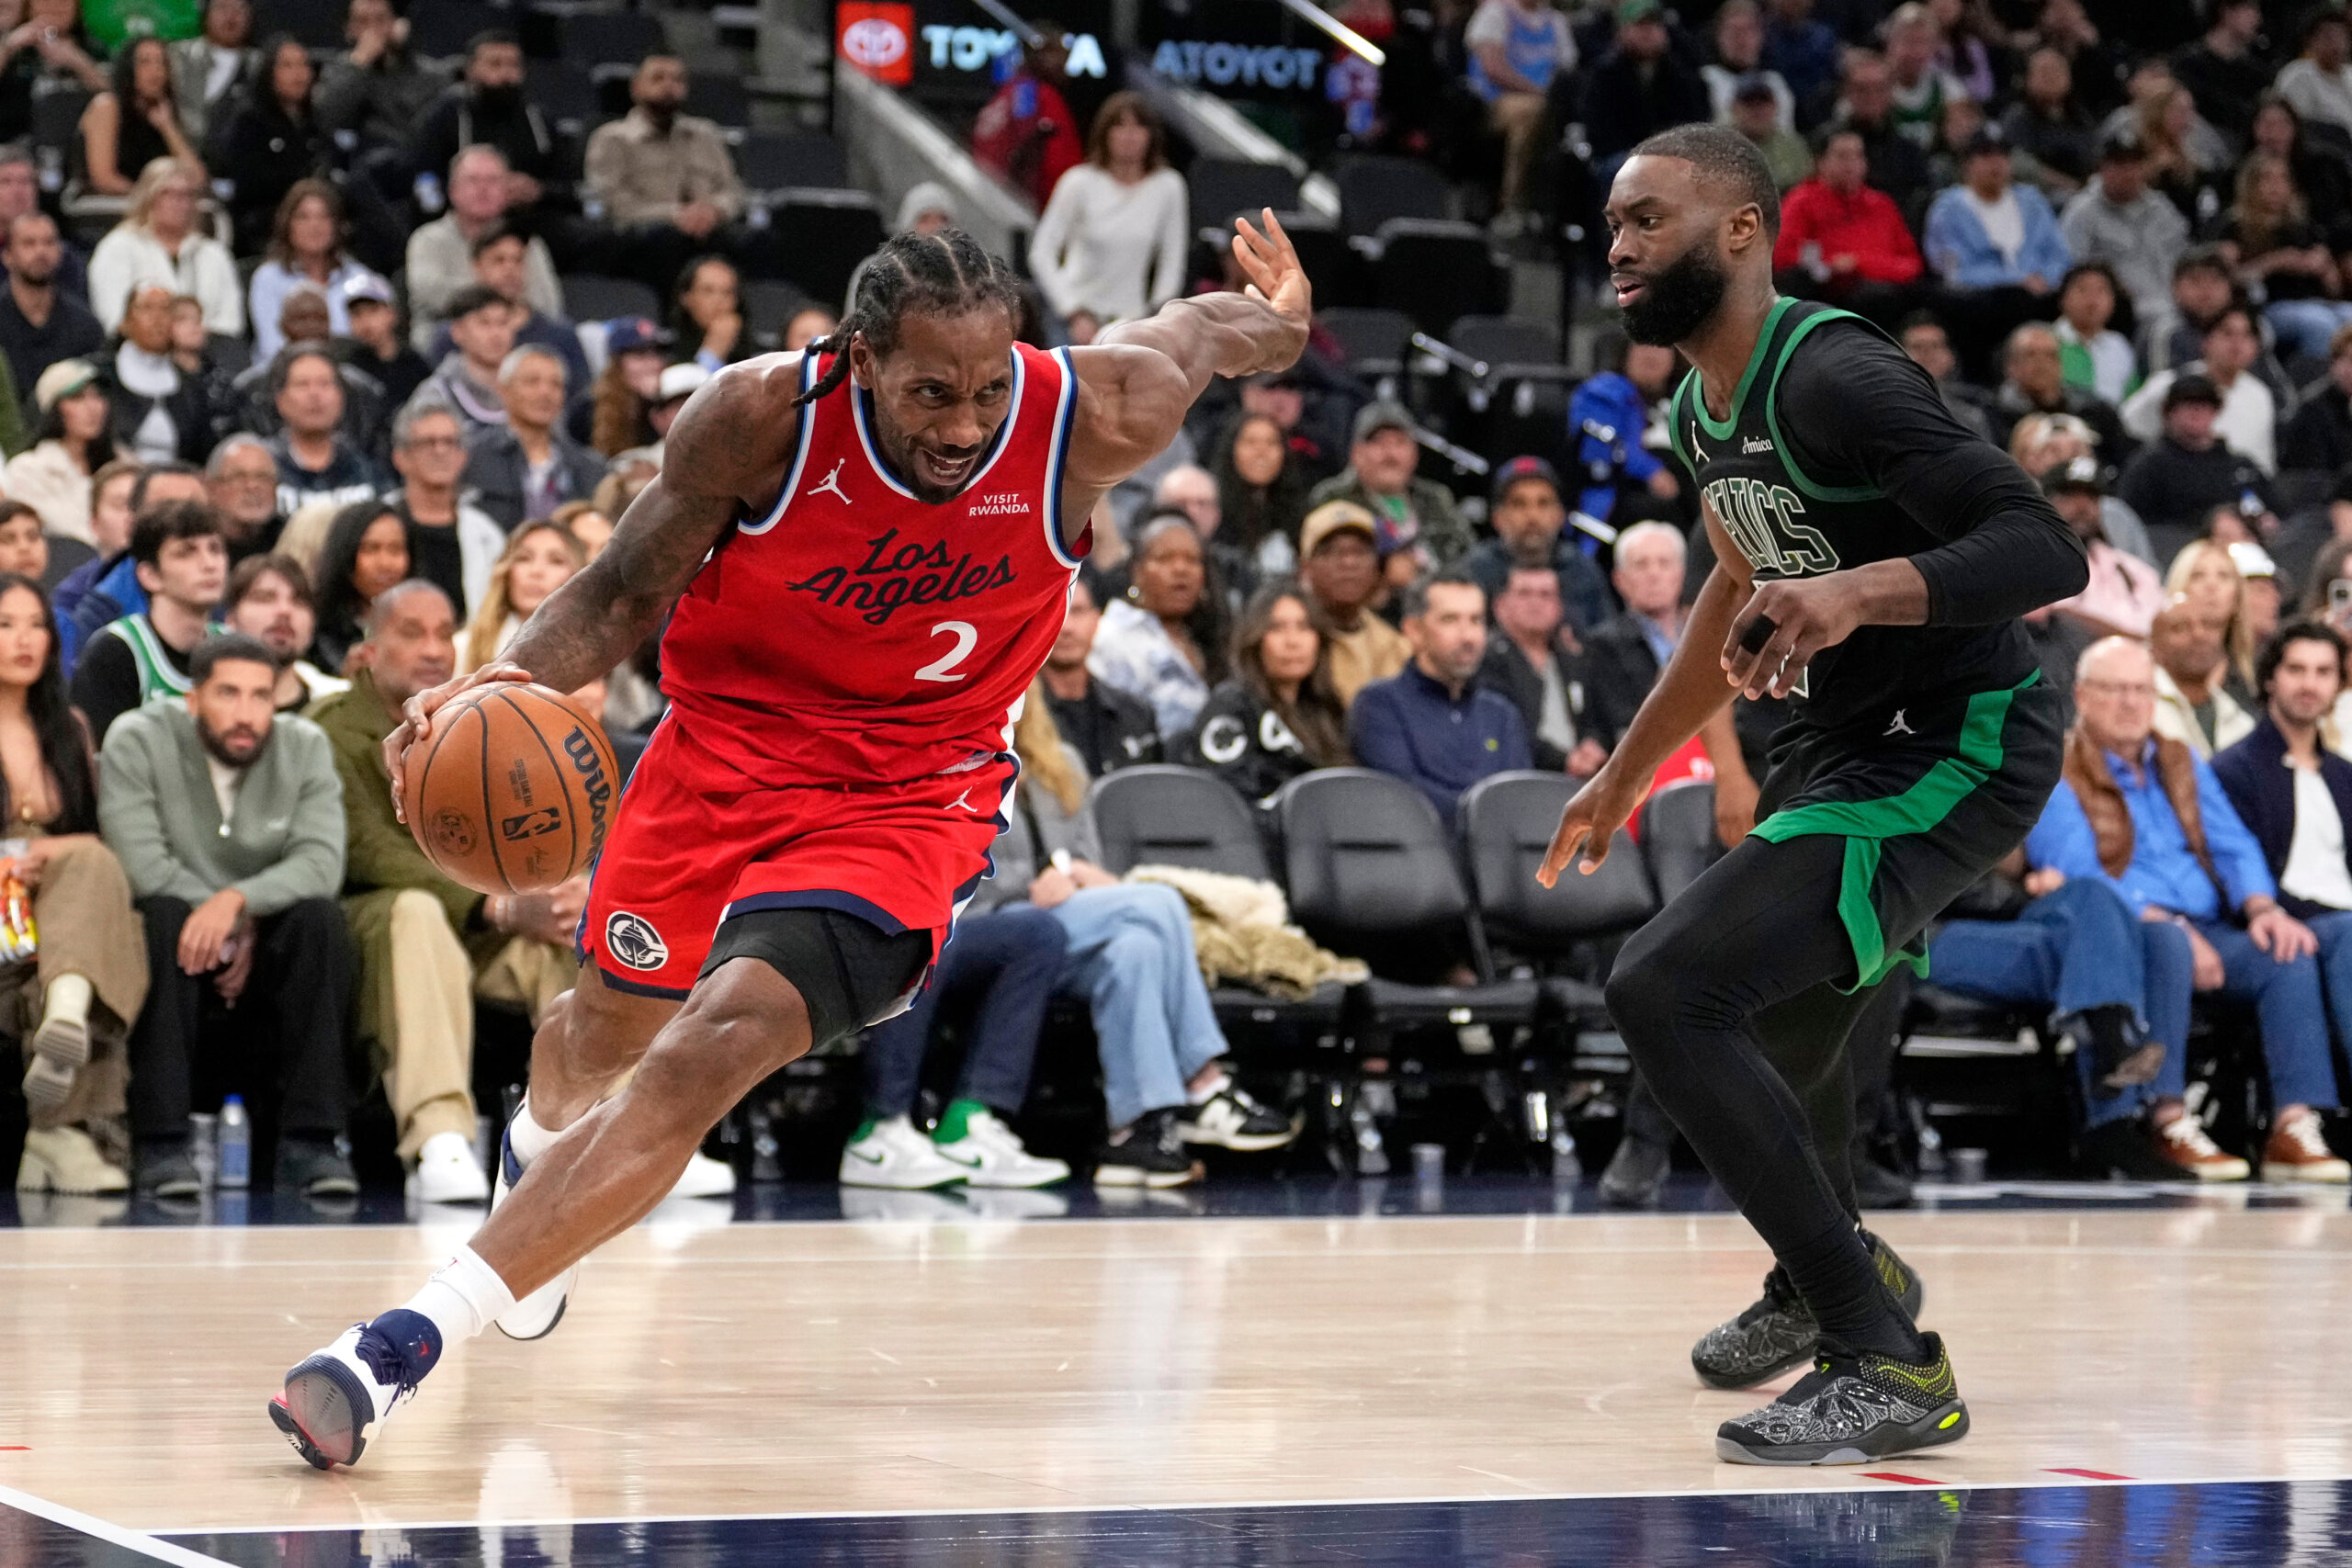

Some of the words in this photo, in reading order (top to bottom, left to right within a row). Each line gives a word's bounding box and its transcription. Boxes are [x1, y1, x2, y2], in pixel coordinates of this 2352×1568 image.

[921, 24, 1107, 79] TOYA
[1742, 435, 1774, 455] Amica
[968, 502, 1030, 517] RWANDA
[982, 493, 1020, 505] VISIT
[854, 526, 956, 577] Los
[785, 553, 1018, 626] Angeles
[914, 620, 978, 682] 2
[562, 725, 611, 867] Wilson
